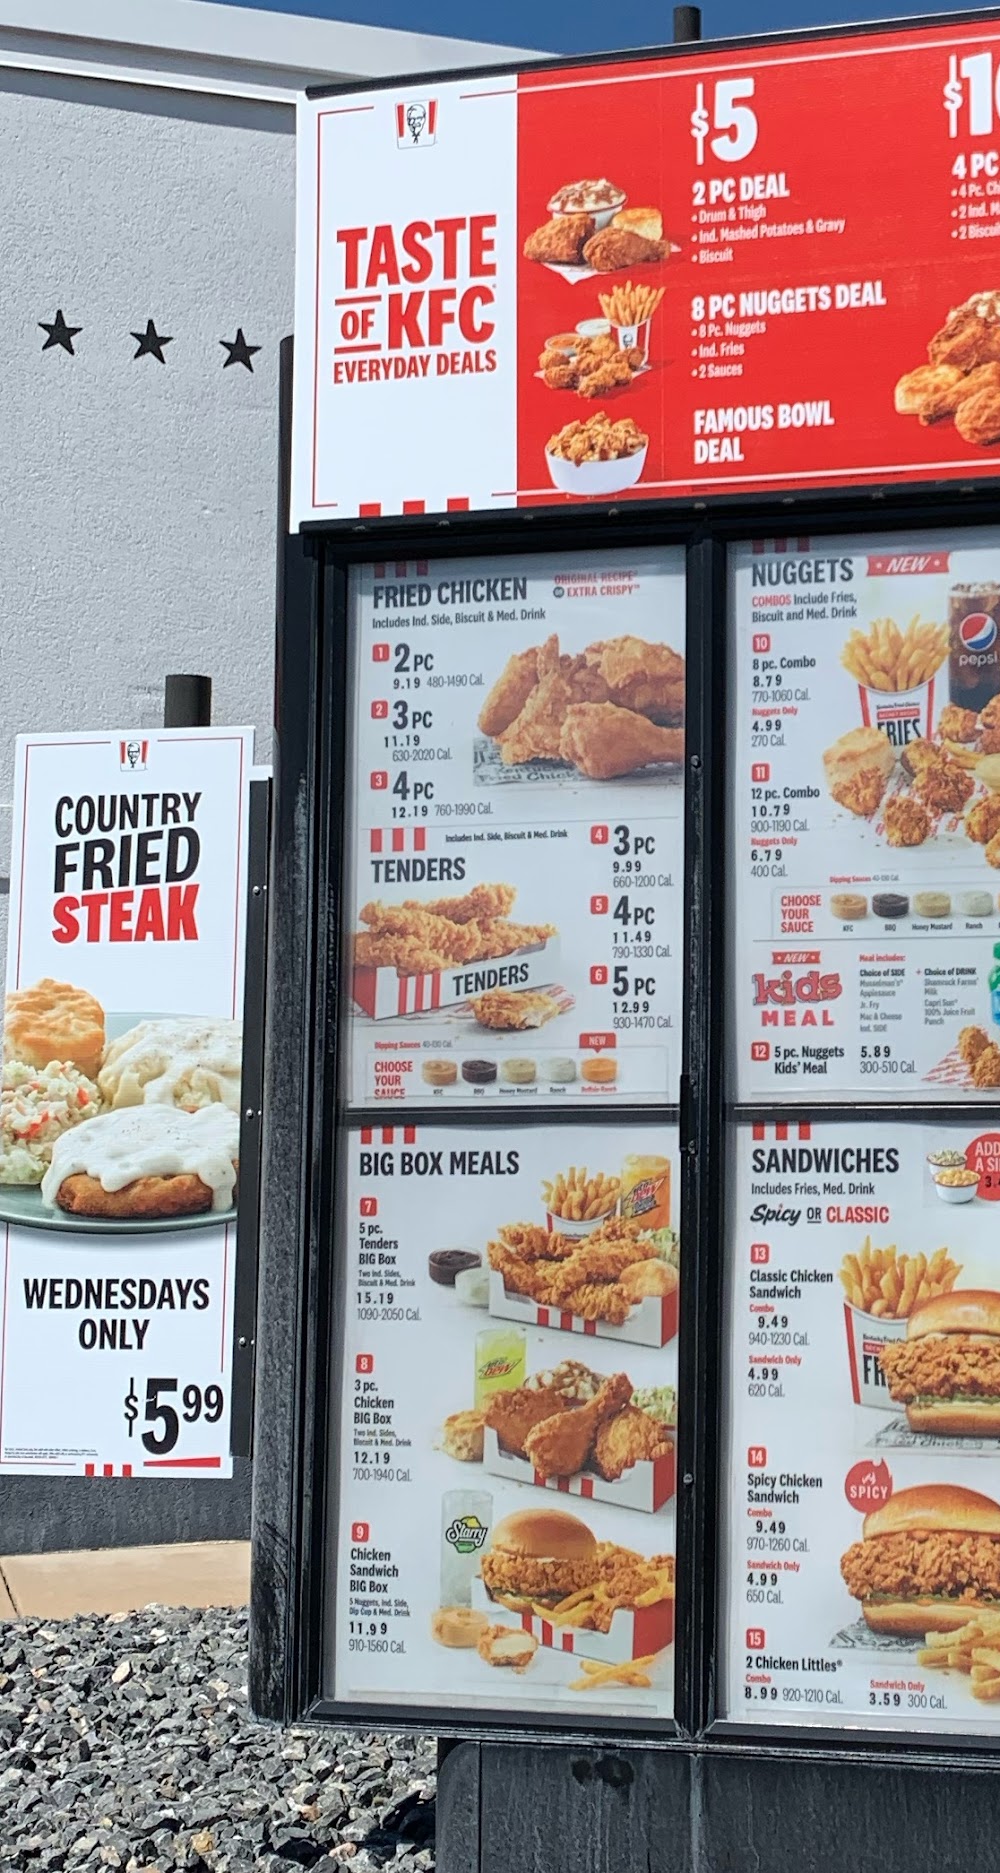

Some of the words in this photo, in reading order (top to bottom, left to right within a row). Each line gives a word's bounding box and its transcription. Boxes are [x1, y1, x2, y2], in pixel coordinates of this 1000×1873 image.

[690, 78, 758, 164] $5
[952, 155, 966, 179] 4
[970, 152, 998, 178] PC
[692, 183, 706, 206] 2
[710, 179, 736, 204] PC
[740, 172, 790, 200] DEAL
[699, 208, 726, 224] Drum
[728, 206, 737, 222] &
[738, 204, 766, 220] Thigh
[699, 228, 720, 243] Ind.
[722, 225, 758, 242] Mashed
[760, 221, 803, 239] Potatoes
[804, 219, 813, 236] &
[816, 218, 846, 236] Gravy
[336, 214, 497, 290] TASTE
[692, 298, 705, 322] 8
[709, 294, 736, 320] PC
[739, 286, 832, 316] NUGGETS
[835, 280, 886, 309] DEAL
[340, 310, 375, 342] OF
[388, 284, 496, 348] KFC
[334, 354, 432, 384] EVERYDAY
[436, 350, 497, 378] DEALS
[694, 405, 775, 434] FAMOUS
[778, 400, 834, 428] BOWL
[694, 437, 744, 464] DEAL
[752, 559, 854, 586] NUGGETS
[886, 557, 931, 574] NEW
[373, 582, 431, 609] FRIED
[437, 577, 527, 604] CHICKEN
[752, 594, 792, 607] COMBOS
[794, 593, 829, 605] Include
[831, 592, 857, 604] Fries,
[372, 616, 410, 629] Includes
[412, 614, 429, 627] Ind.
[431, 613, 453, 626] Side,
[455, 611, 485, 624] Biscuit
[488, 611, 494, 622] &
[497, 610, 518, 622] Med.
[521, 608, 546, 620] Drink
[753, 659, 759, 669] 8
[762, 659, 777, 672] pc.
[780, 656, 816, 669] Combo
[393, 678, 420, 689] 9.19
[753, 675, 782, 687] 8.79
[752, 720, 781, 732] 4.99
[384, 735, 420, 748] 11.19
[55, 792, 202, 838] COUNTRY
[392, 806, 428, 818] 12.19
[54, 826, 200, 893] FRIED
[613, 861, 641, 873] 9.99
[371, 857, 466, 883] TENDERS
[781, 895, 821, 907] CHOOSE
[52, 884, 199, 944] STEAK
[781, 908, 809, 920] YOUR
[781, 921, 814, 933] SAUCE
[613, 931, 651, 943] 11.49
[453, 963, 529, 996] TENDERS
[613, 1002, 649, 1013] 12.99
[761, 1009, 834, 1026] MEAL
[861, 1046, 890, 1058] 5.89
[360, 1153, 393, 1176] BIG
[401, 1153, 443, 1176] BOX
[450, 1151, 519, 1175] MEALS
[752, 1148, 899, 1173] SANDWICHES
[975, 1158, 984, 1172] A
[751, 1183, 792, 1195] Includes
[795, 1183, 820, 1196] Fries,
[823, 1183, 846, 1194] Med.
[849, 1183, 874, 1195] Drink
[750, 1203, 801, 1226] Spicy
[807, 1208, 821, 1220] OR
[827, 1206, 889, 1223] CLASSIC
[359, 1238, 398, 1249] Tenders
[750, 1270, 788, 1283] Classic
[790, 1271, 833, 1283] Chicken
[24, 1278, 210, 1310] WEDNESDAYS
[357, 1292, 393, 1304] 15.19
[750, 1286, 801, 1298] Sandwich
[758, 1316, 788, 1328] 9.49
[78, 1318, 150, 1350] ONLY
[354, 1451, 390, 1464] 12.19
[747, 1474, 777, 1489] Spicy
[779, 1475, 823, 1488] Chicken
[747, 1490, 799, 1504] Sandwich
[850, 1485, 888, 1499] SPICY
[755, 1521, 786, 1533] 9.49
[350, 1565, 399, 1577] Sandwich
[349, 1622, 387, 1635] 11.99
[869, 1693, 901, 1706] 3.59
